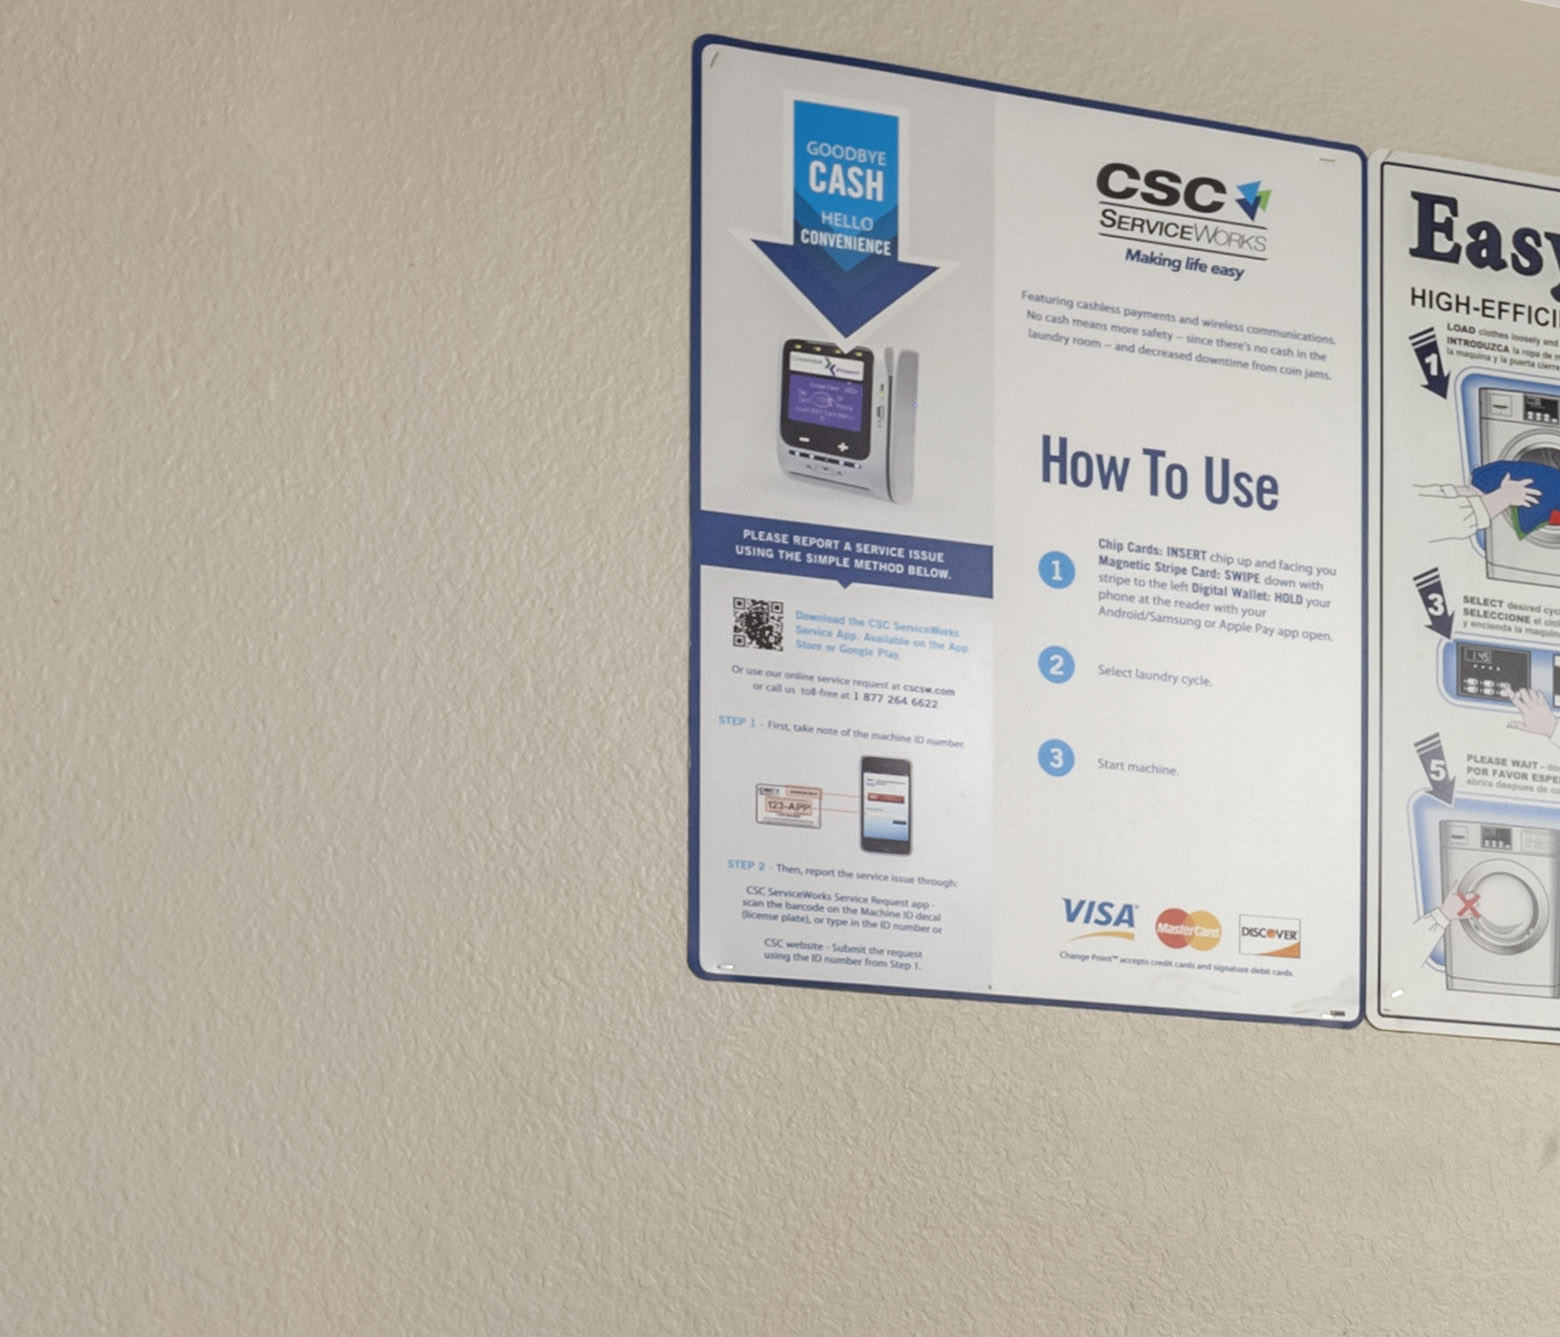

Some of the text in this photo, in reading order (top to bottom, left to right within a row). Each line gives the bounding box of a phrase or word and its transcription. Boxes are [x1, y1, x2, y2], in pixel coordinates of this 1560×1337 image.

[806, 140, 885, 166] GOODBYE
[809, 160, 883, 201] CASH
[1096, 162, 1226, 213] CSC
[821, 210, 873, 231] HELLO
[800, 228, 891, 256] CONVENIENCE
[1125, 247, 1244, 281] Making life easy
[1424, 351, 1442, 375] 1
[1042, 434, 1278, 510] How To Use
[743, 528, 944, 563] PLEASE REPORT A SERVICE ISSUE
[1098, 537, 1207, 560] Chip Cards: INSERT
[735, 544, 951, 579] USING THE SIMPLE METHOD BELOW.
[1051, 559, 1062, 580] 1
[1426, 593, 1446, 616] 3
[1463, 595, 1503, 607] SELECT
[1049, 654, 1063, 675] 2
[1097, 663, 1210, 686] Select laundry cycle.
[1050, 747, 1063, 768] 3
[1097, 757, 1176, 776] Start machine.
[1427, 759, 1447, 782] 5
[1063, 898, 1134, 927] VISA
